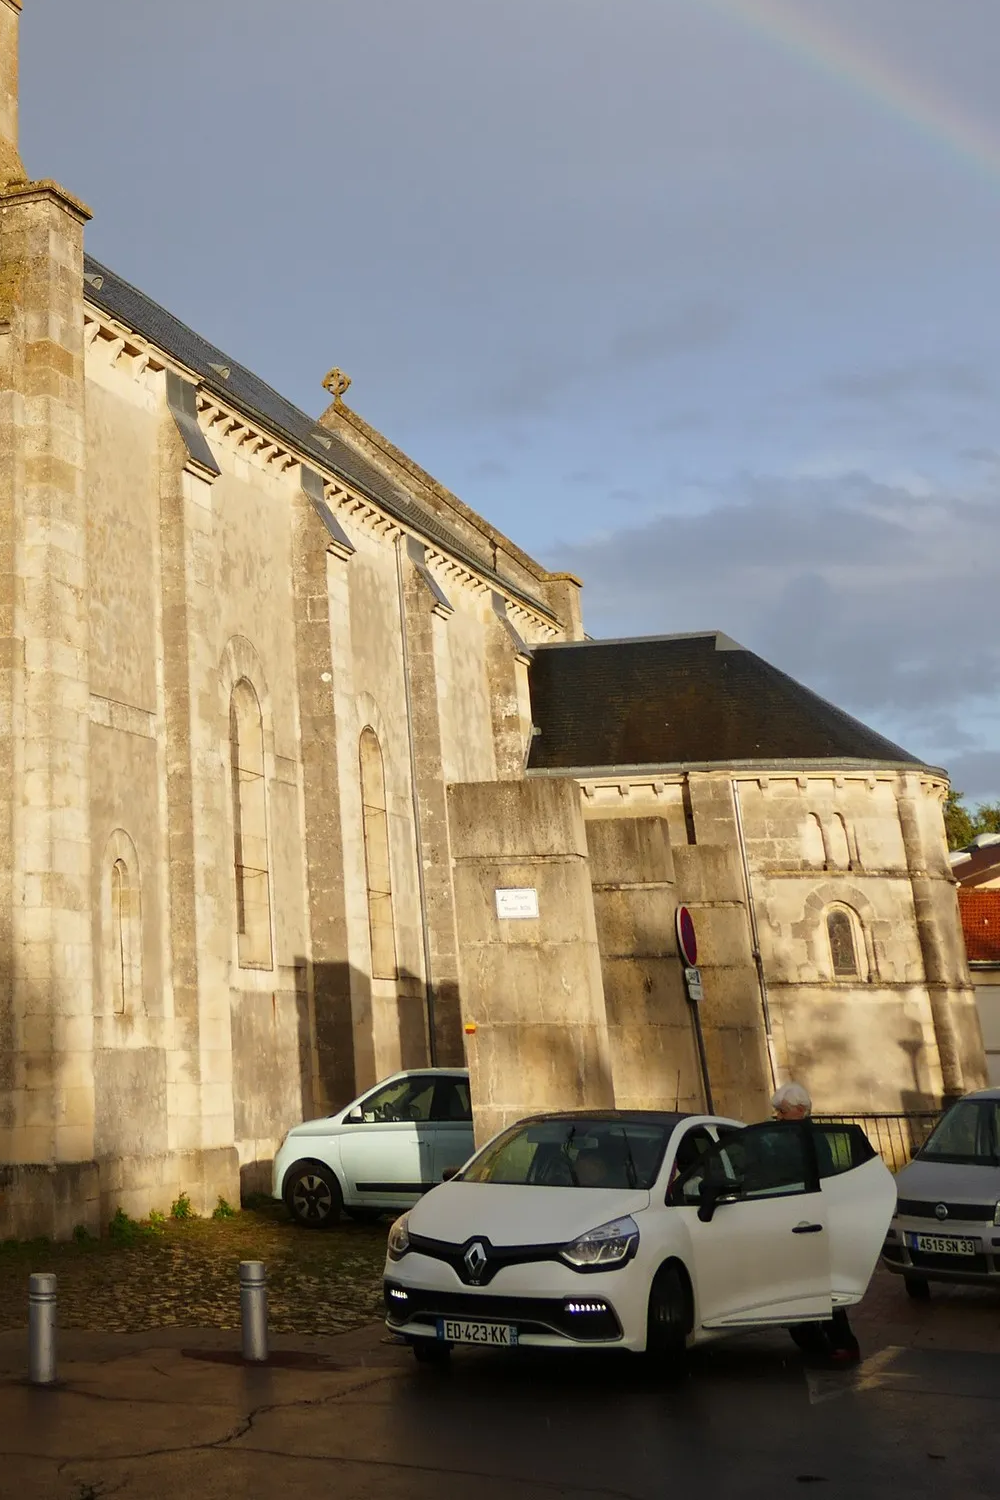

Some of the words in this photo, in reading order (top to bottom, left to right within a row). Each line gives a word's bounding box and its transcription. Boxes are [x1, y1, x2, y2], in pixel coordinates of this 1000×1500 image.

[920, 1238, 945, 1251] 4515
[945, 1240, 959, 1252] SN
[961, 1240, 974, 1252] 33
